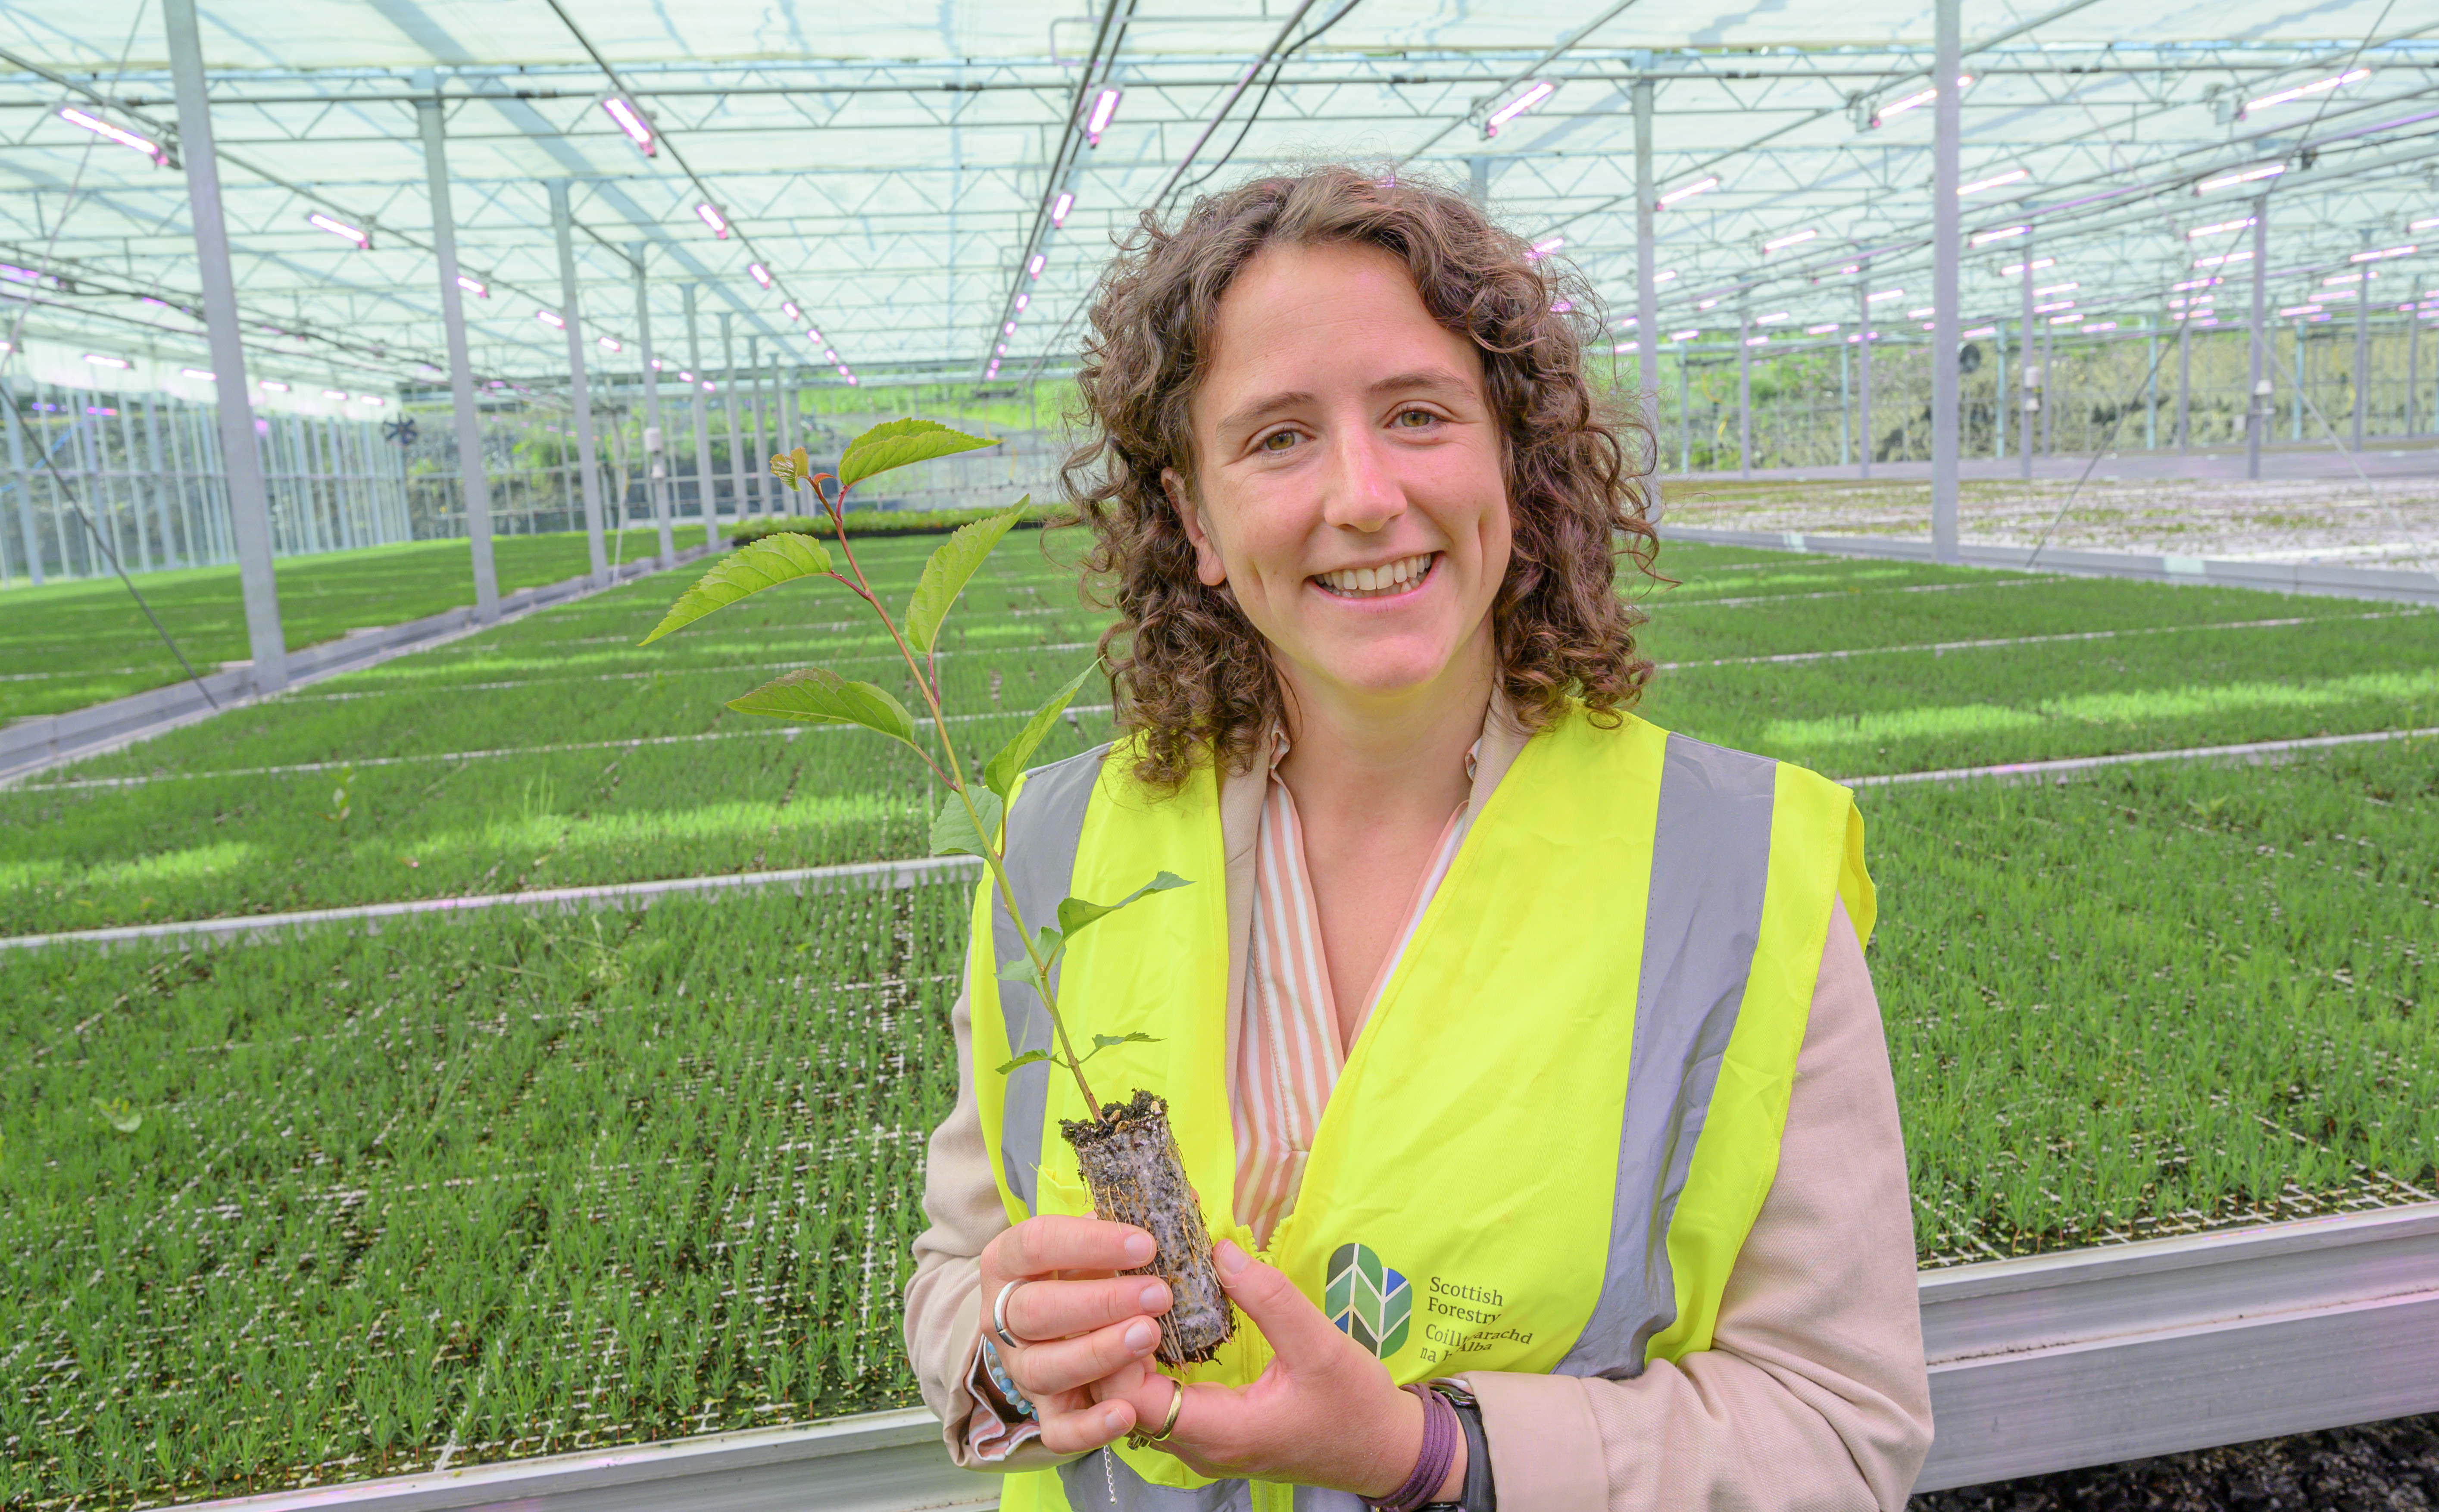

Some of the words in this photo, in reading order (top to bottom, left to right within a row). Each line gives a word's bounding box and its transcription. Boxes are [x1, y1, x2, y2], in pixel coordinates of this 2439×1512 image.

[1430, 1277, 1503, 1306] Scottish
[1427, 1296, 1502, 1325] Forestry
[1420, 1347, 1437, 1362] na
